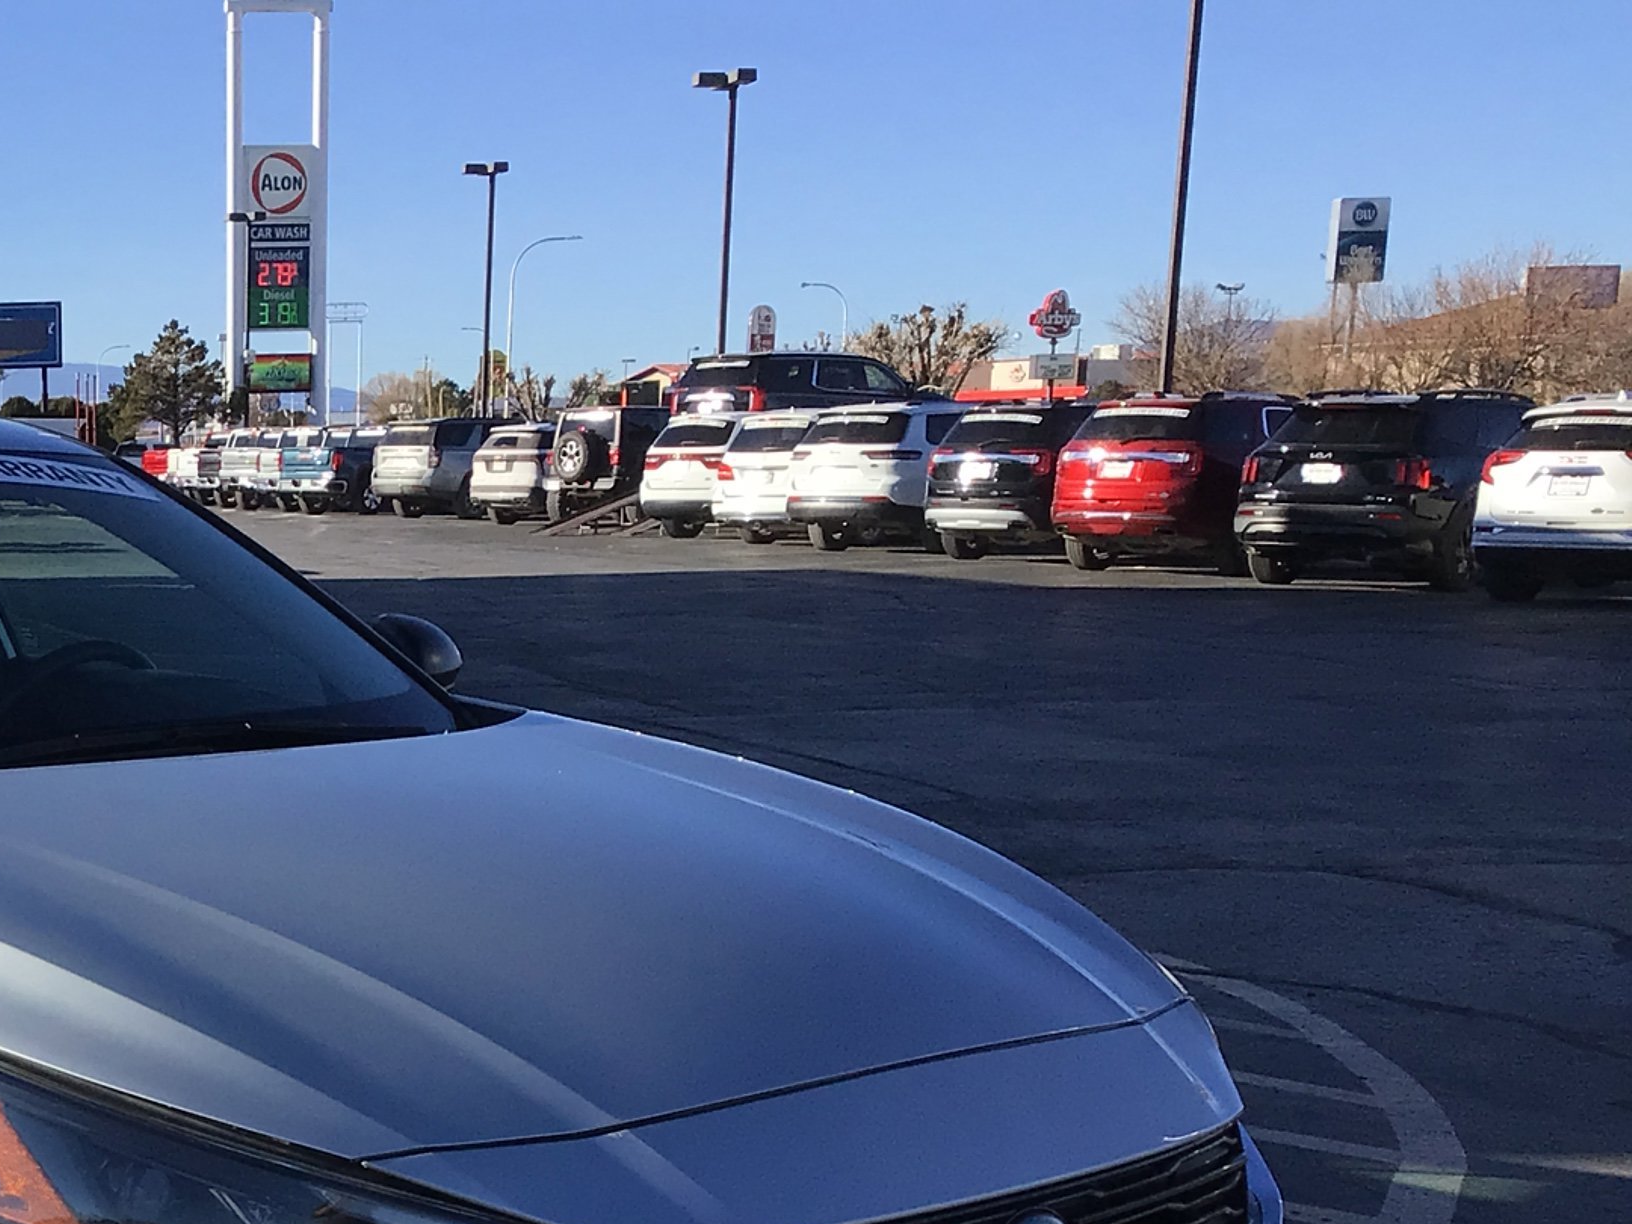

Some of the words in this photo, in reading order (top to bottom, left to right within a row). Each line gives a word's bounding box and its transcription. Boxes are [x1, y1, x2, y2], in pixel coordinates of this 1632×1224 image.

[261, 173, 302, 191] ALON
[250, 226, 273, 240] CAR
[274, 226, 308, 239] WASH
[255, 249, 303, 261] Unleaded
[263, 288, 295, 300] Diesel
